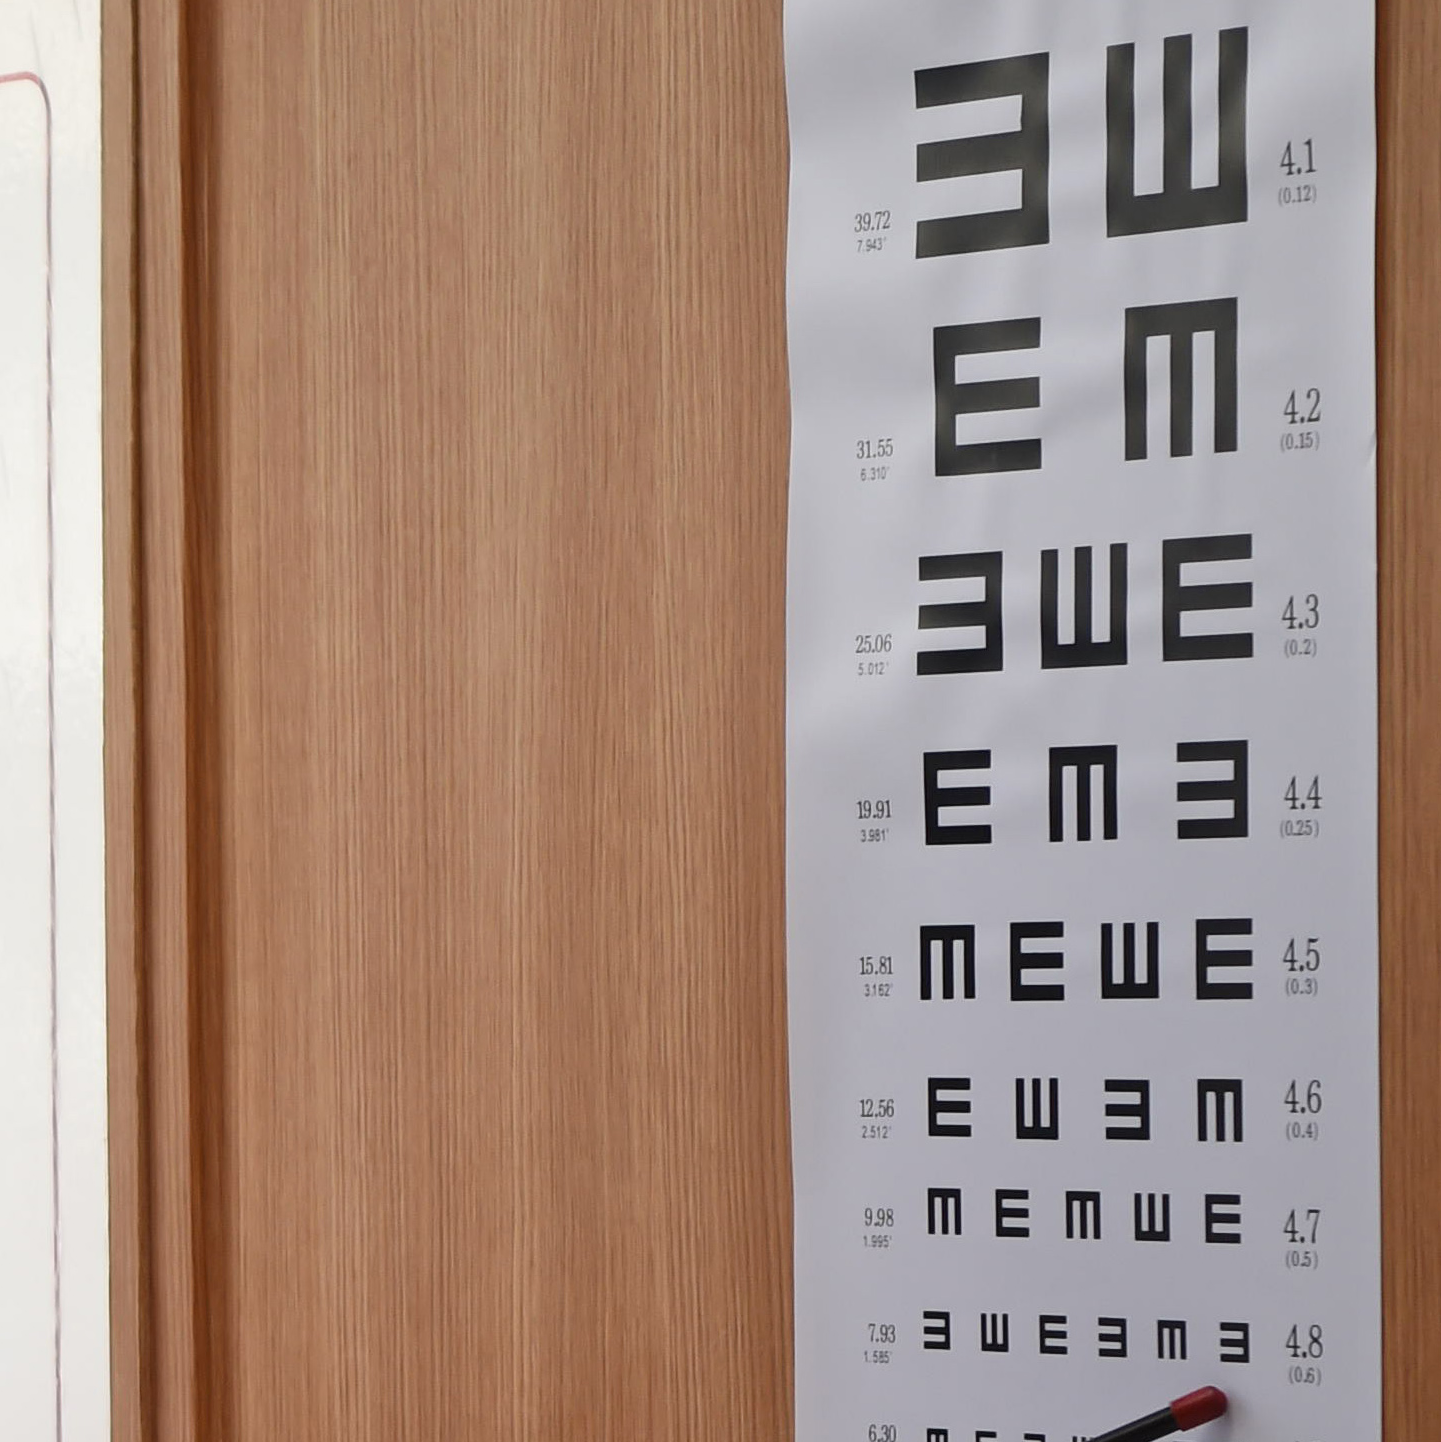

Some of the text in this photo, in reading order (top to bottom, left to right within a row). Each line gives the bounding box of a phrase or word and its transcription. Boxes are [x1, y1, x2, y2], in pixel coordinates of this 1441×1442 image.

[1279, 138, 1317, 177] 4.1
[1277, 184, 1317, 206] (0.12)
[853, 209, 891, 233] 39.72
[1283, 387, 1322, 425] 4.2
[856, 437, 894, 460] 31.55
[1279, 431, 1321, 453] (0.15)
[1281, 593, 1320, 630] 4.3
[854, 633, 893, 654] 25.06
[1283, 638, 1318, 659] (0.2)
[1283, 775, 1323, 811] 4.4
[856, 799, 892, 820] 19.91
[1279, 819, 1320, 839] (0.25)
[859, 955, 894, 976] 15.81
[1282, 937, 1321, 973] 4.5
[1284, 977, 1319, 997] (0.3)
[1283, 1079, 1323, 1115] 4.6
[859, 1098, 895, 1119] 12.56
[1285, 1121, 1319, 1141] (0.4)
[864, 1207, 895, 1228] 9.98
[1282, 1208, 1321, 1244] 4.7
[1285, 1250, 1319, 1270] (0.5)
[867, 1322, 896, 1344] 7.93
[1285, 1323, 1324, 1359] 4.8
[1288, 1365, 1322, 1387] (0.6)
